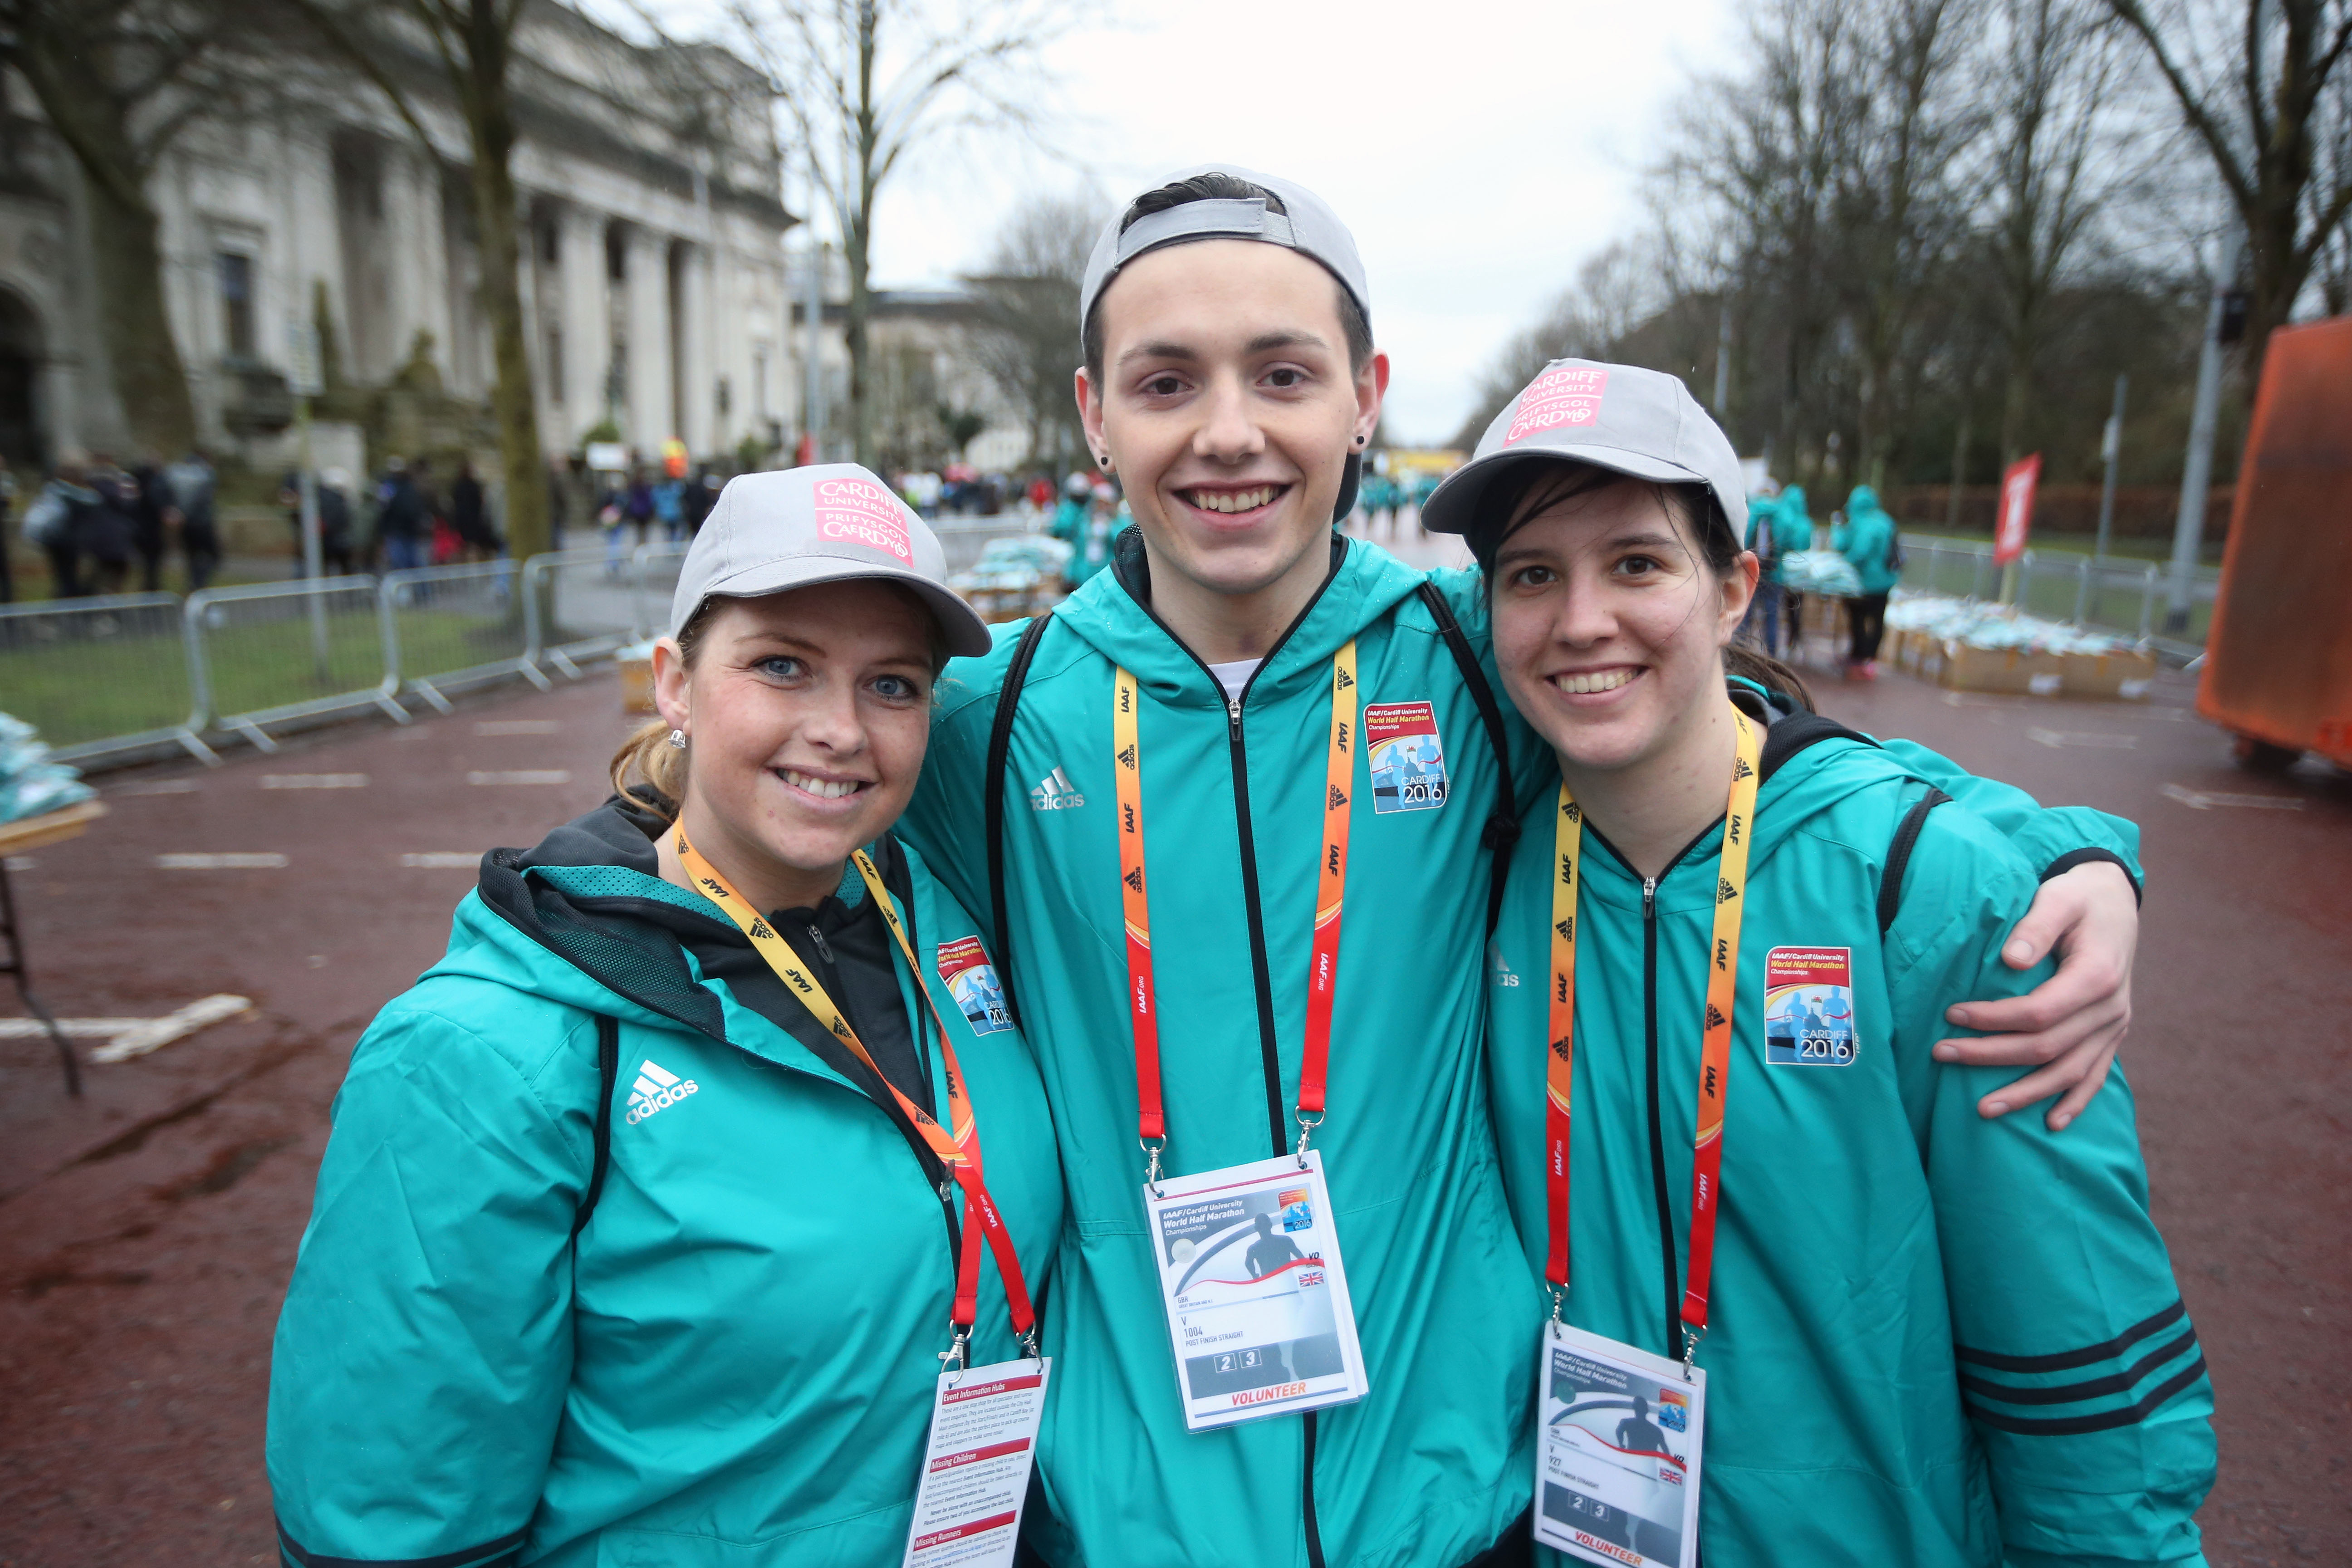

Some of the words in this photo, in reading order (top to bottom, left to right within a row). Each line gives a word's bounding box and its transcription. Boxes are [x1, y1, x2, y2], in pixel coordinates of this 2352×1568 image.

[1521, 384, 1596, 409] UNIVERSITY
[1523, 371, 1602, 402] CARDIFF
[1514, 400, 1590, 425] PRIFYSGOL
[819, 482, 901, 515] CARDIFF
[824, 497, 902, 525] UNIVERSITY
[826, 513, 905, 544] PRIFYSGOL
[1121, 686, 1130, 713] IAAF
[1338, 722, 1348, 754] IAAF
[1401, 774, 1441, 786] CARDIFF
[1403, 783, 1442, 803] 2016
[1124, 803, 1134, 833] IAAF
[1729, 813, 1741, 845] IAAF
[858, 856, 877, 880] IAAF
[1328, 843, 1339, 877] IAAF
[1562, 853, 1571, 884] IAAF
[701, 878, 730, 897] IAAF
[754, 917, 774, 939] adidas
[1713, 938, 1727, 971] IAAF
[1809, 961, 1845, 969] Marathon
[785, 969, 813, 993] IAAF
[1558, 972, 1567, 1003] IAAF
[834, 1015, 852, 1039] adidas
[989, 1009, 1012, 1025] 2016
[1705, 1003, 1714, 1031] adidas
[1800, 1029, 1848, 1039] CARDIFF
[1801, 1039, 1849, 1058] 2016
[946, 1071, 958, 1099] IAAF
[1704, 1065, 1716, 1099] IAAF
[626, 1079, 699, 1125] adidas
[1163, 1205, 1209, 1219] IAAF/Cardiff
[1209, 1200, 1243, 1211] University
[1164, 1217, 1187, 1229] World
[1189, 1214, 1205, 1224] Half
[1206, 1208, 1244, 1221] Marathon
[1166, 1224, 1207, 1236] Championships
[1294, 1220, 1311, 1229] 2016
[1308, 1252, 1319, 1260] VO
[1181, 1316, 1186, 1326] V
[1184, 1326, 1202, 1338] 1004
[1200, 1336, 1217, 1344] FINISH
[1218, 1331, 1243, 1341] STRAIGHT
[1221, 1356, 1230, 1371] 2
[1246, 1351, 1255, 1365] 3
[942, 1391, 960, 1401] Event
[959, 1385, 991, 1398] Information
[991, 1382, 1006, 1392] Hubs
[1232, 1382, 1307, 1406] VOLUNTEER
[931, 1459, 953, 1470] Missing
[952, 1452, 977, 1463] Children
[1572, 1496, 1583, 1509] 2
[1595, 1504, 1605, 1517] 3
[914, 1535, 938, 1548] Missing
[936, 1529, 963, 1541] Runners
[1575, 1530, 1642, 1566] VOLUNTEER
